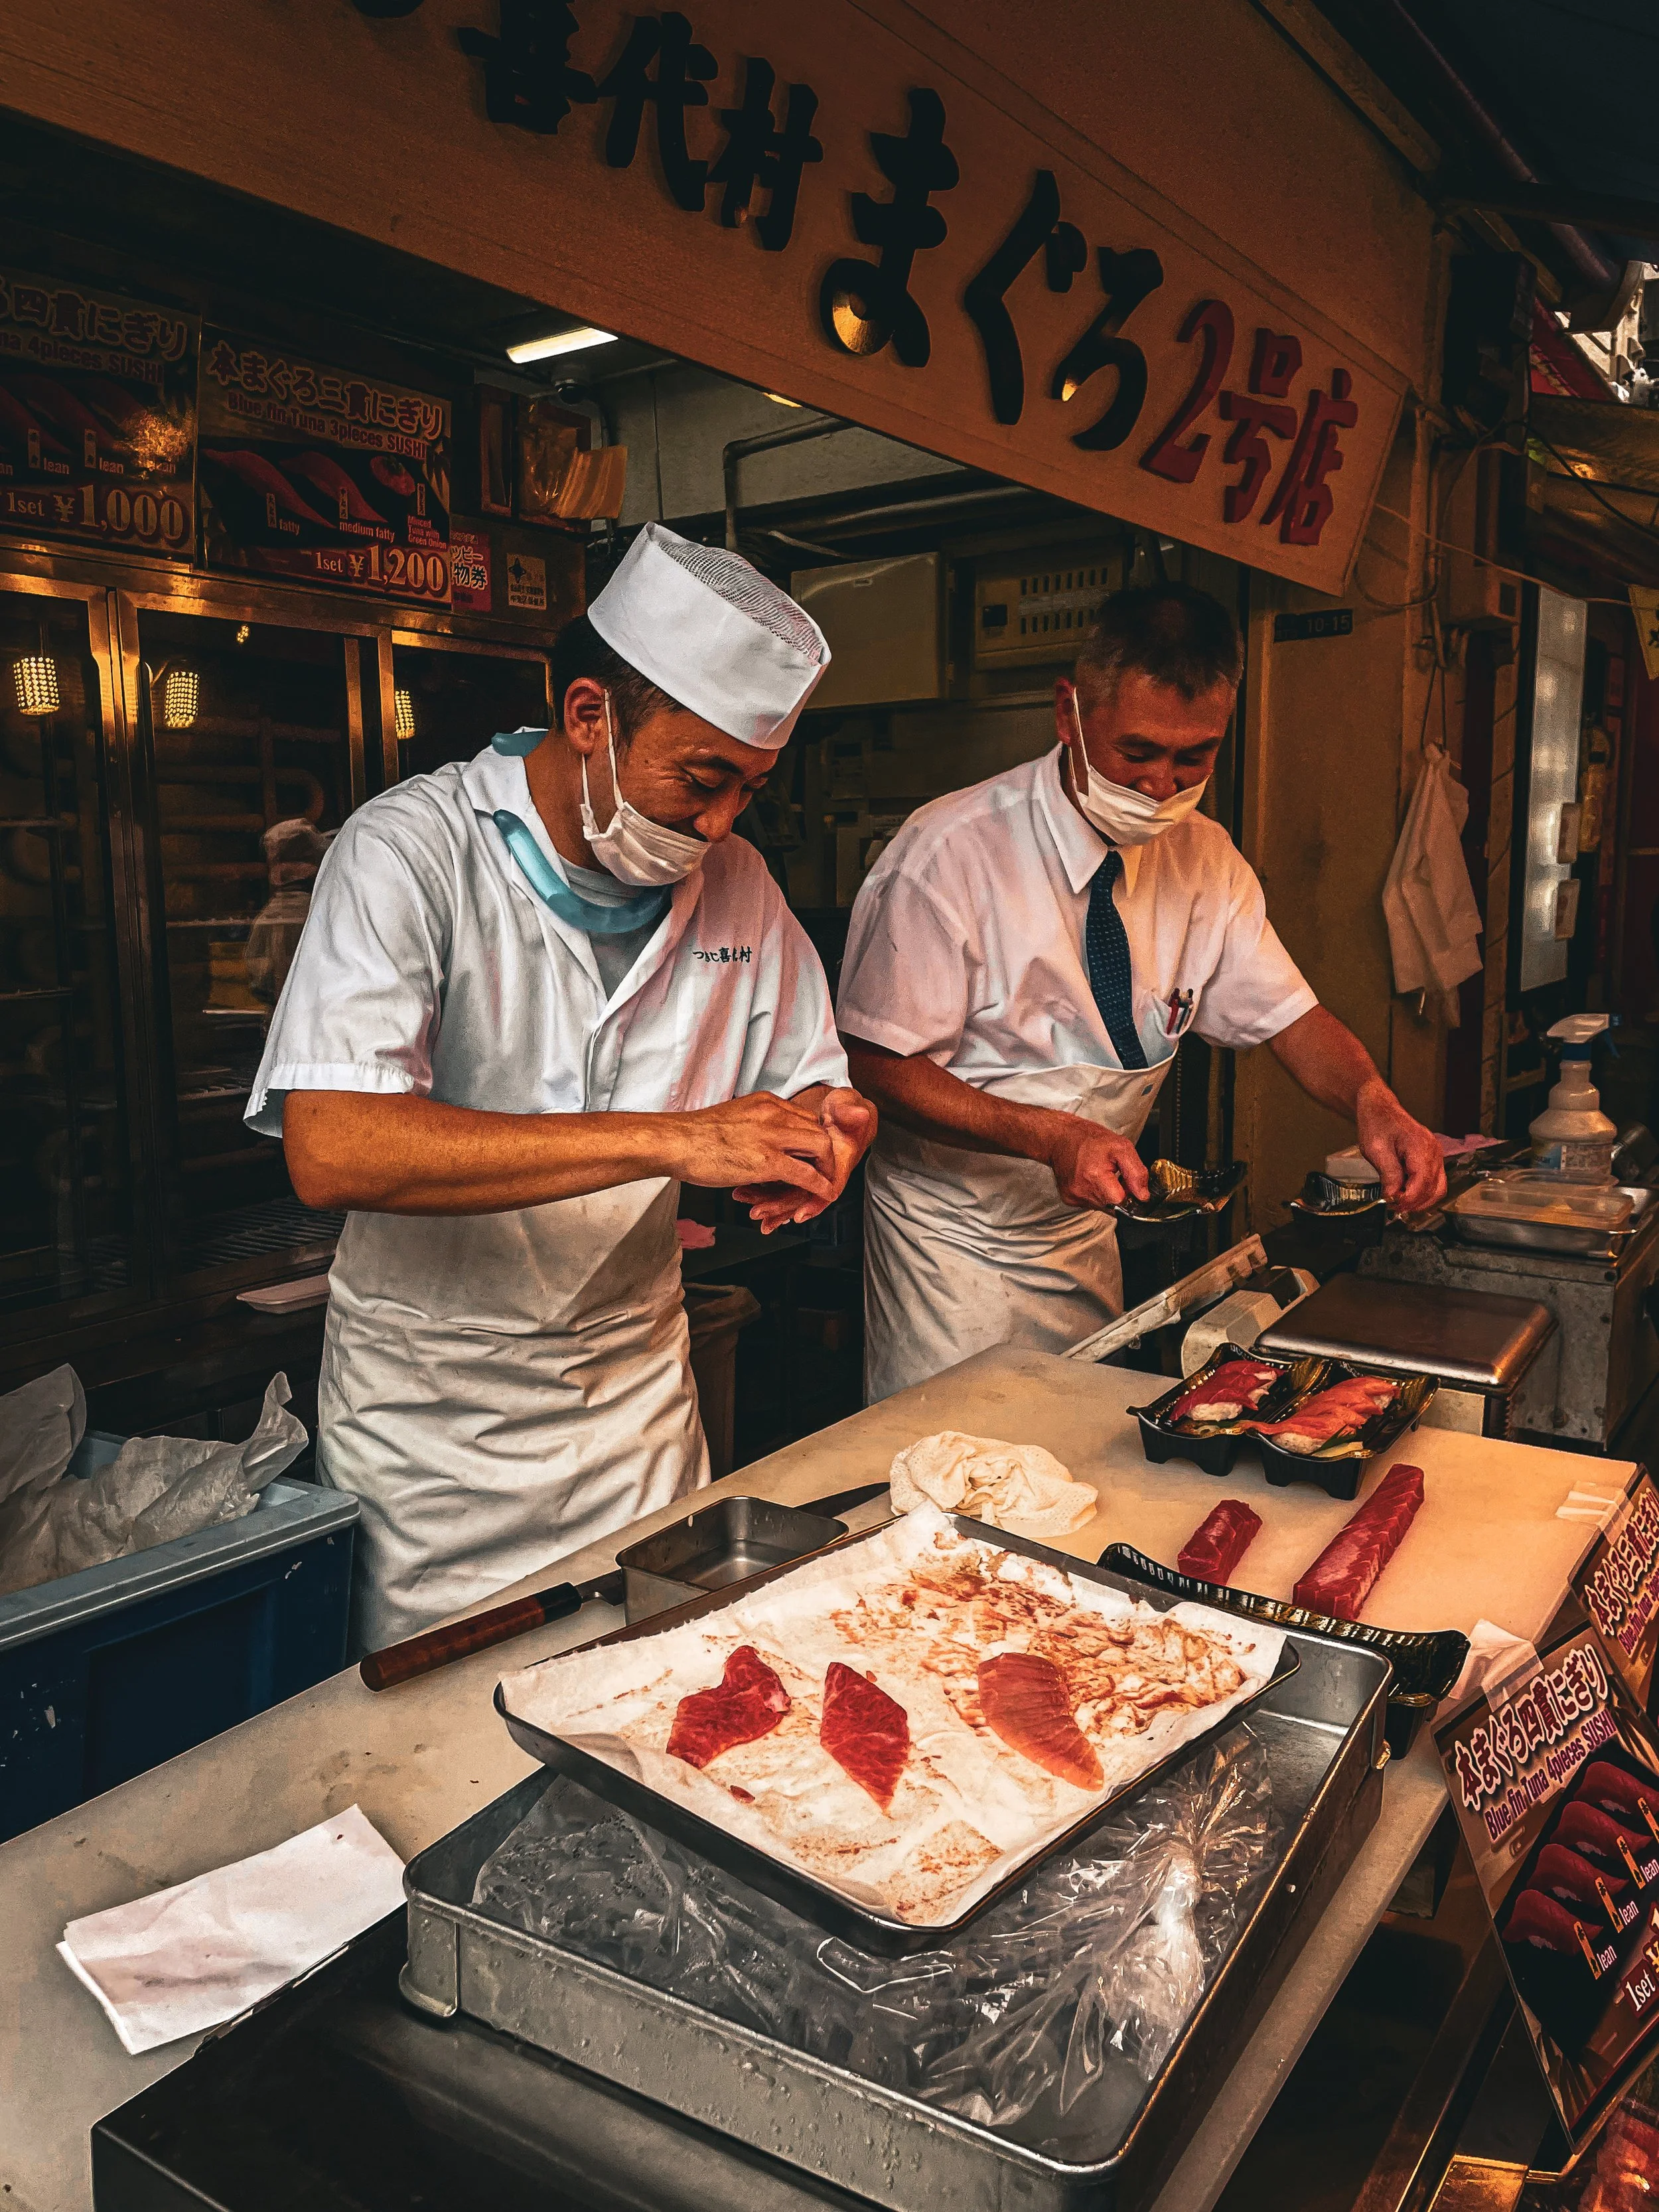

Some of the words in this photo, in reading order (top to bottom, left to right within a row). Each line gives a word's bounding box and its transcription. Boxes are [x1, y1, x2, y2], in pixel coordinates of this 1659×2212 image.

[0, 276, 186, 361] 四貫にぎり
[0, 332, 21, 352] na
[29, 334, 102, 370] 4pieces
[108, 354, 165, 385] SUSHI
[228, 392, 262, 417] Blue
[291, 408, 326, 433] Tuna
[330, 419, 383, 448] 3pieces
[387, 435, 427, 459] SUSHI
[0, 463, 13, 477] an
[43, 457, 70, 475] lean
[99, 457, 124, 474] lean
[7, 491, 46, 517] 1set
[53, 484, 184, 541] ¥1,000
[407, 515, 431, 528] Minced
[279, 518, 301, 537] fatty
[339, 521, 374, 538] medium
[375, 526, 396, 544] fatty
[408, 525, 424, 536] Tuna
[425, 528, 440, 541] with
[408, 533, 427, 546] Green
[428, 538, 447, 550] Onion
[315, 552, 344, 573] 1set
[348, 544, 445, 592] ¥1,200
[450, 560, 488, 590] 物券
[1617, 1625, 1637, 1656] Blue
[1455, 1643, 1607, 1811] 本まぐろ四貫にぎり
[1484, 1803, 1514, 1842] Blue
[1508, 1788, 1526, 1818] fin
[1521, 1768, 1550, 1803] Tuna
[1546, 1737, 1586, 1784] 4pieces
[1581, 1708, 1617, 1751] SUSHI
[1640, 1858, 1659, 1883] lean
[1618, 1900, 1640, 1925] lean
[1596, 1944, 1618, 1972] lean
[1625, 1968, 1656, 2012] 1set
